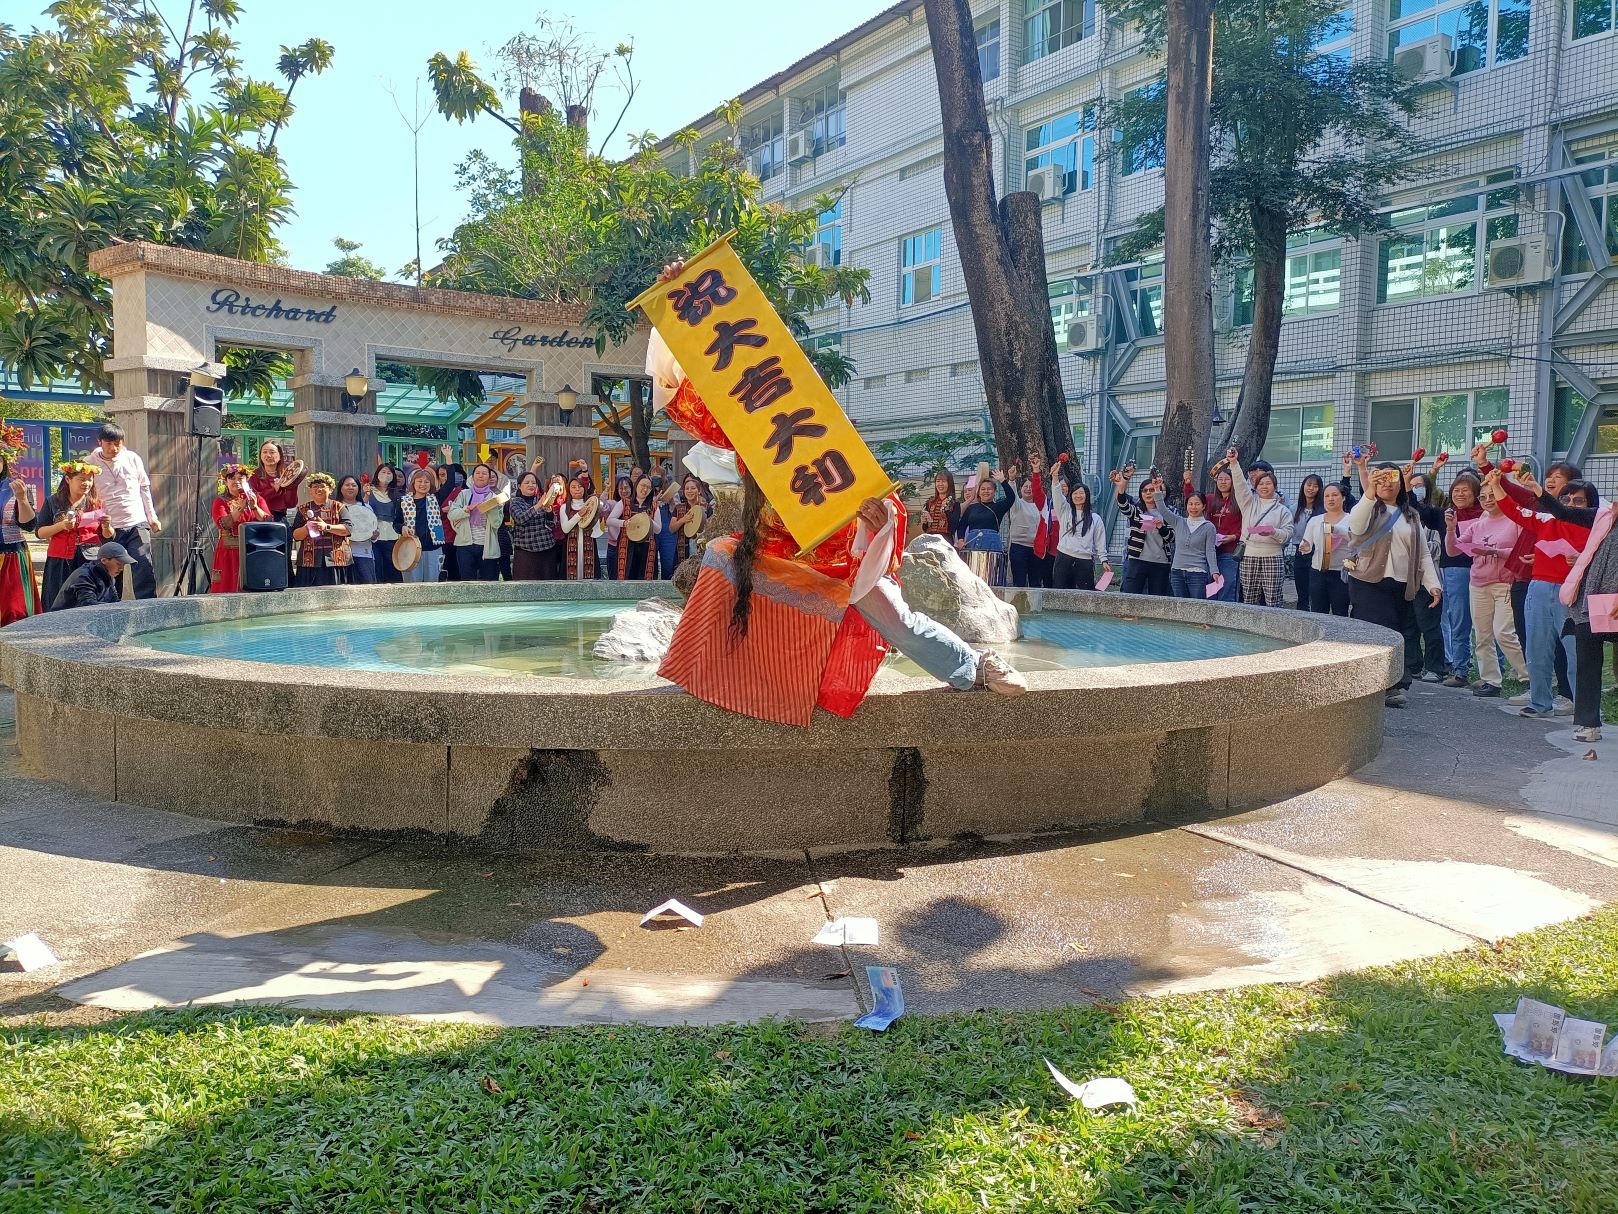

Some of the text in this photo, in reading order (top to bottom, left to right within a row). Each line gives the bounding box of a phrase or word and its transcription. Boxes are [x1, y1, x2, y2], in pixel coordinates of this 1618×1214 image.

[206, 288, 596, 352] Richard Garden
[667, 268, 857, 507] 祝大吉大利
